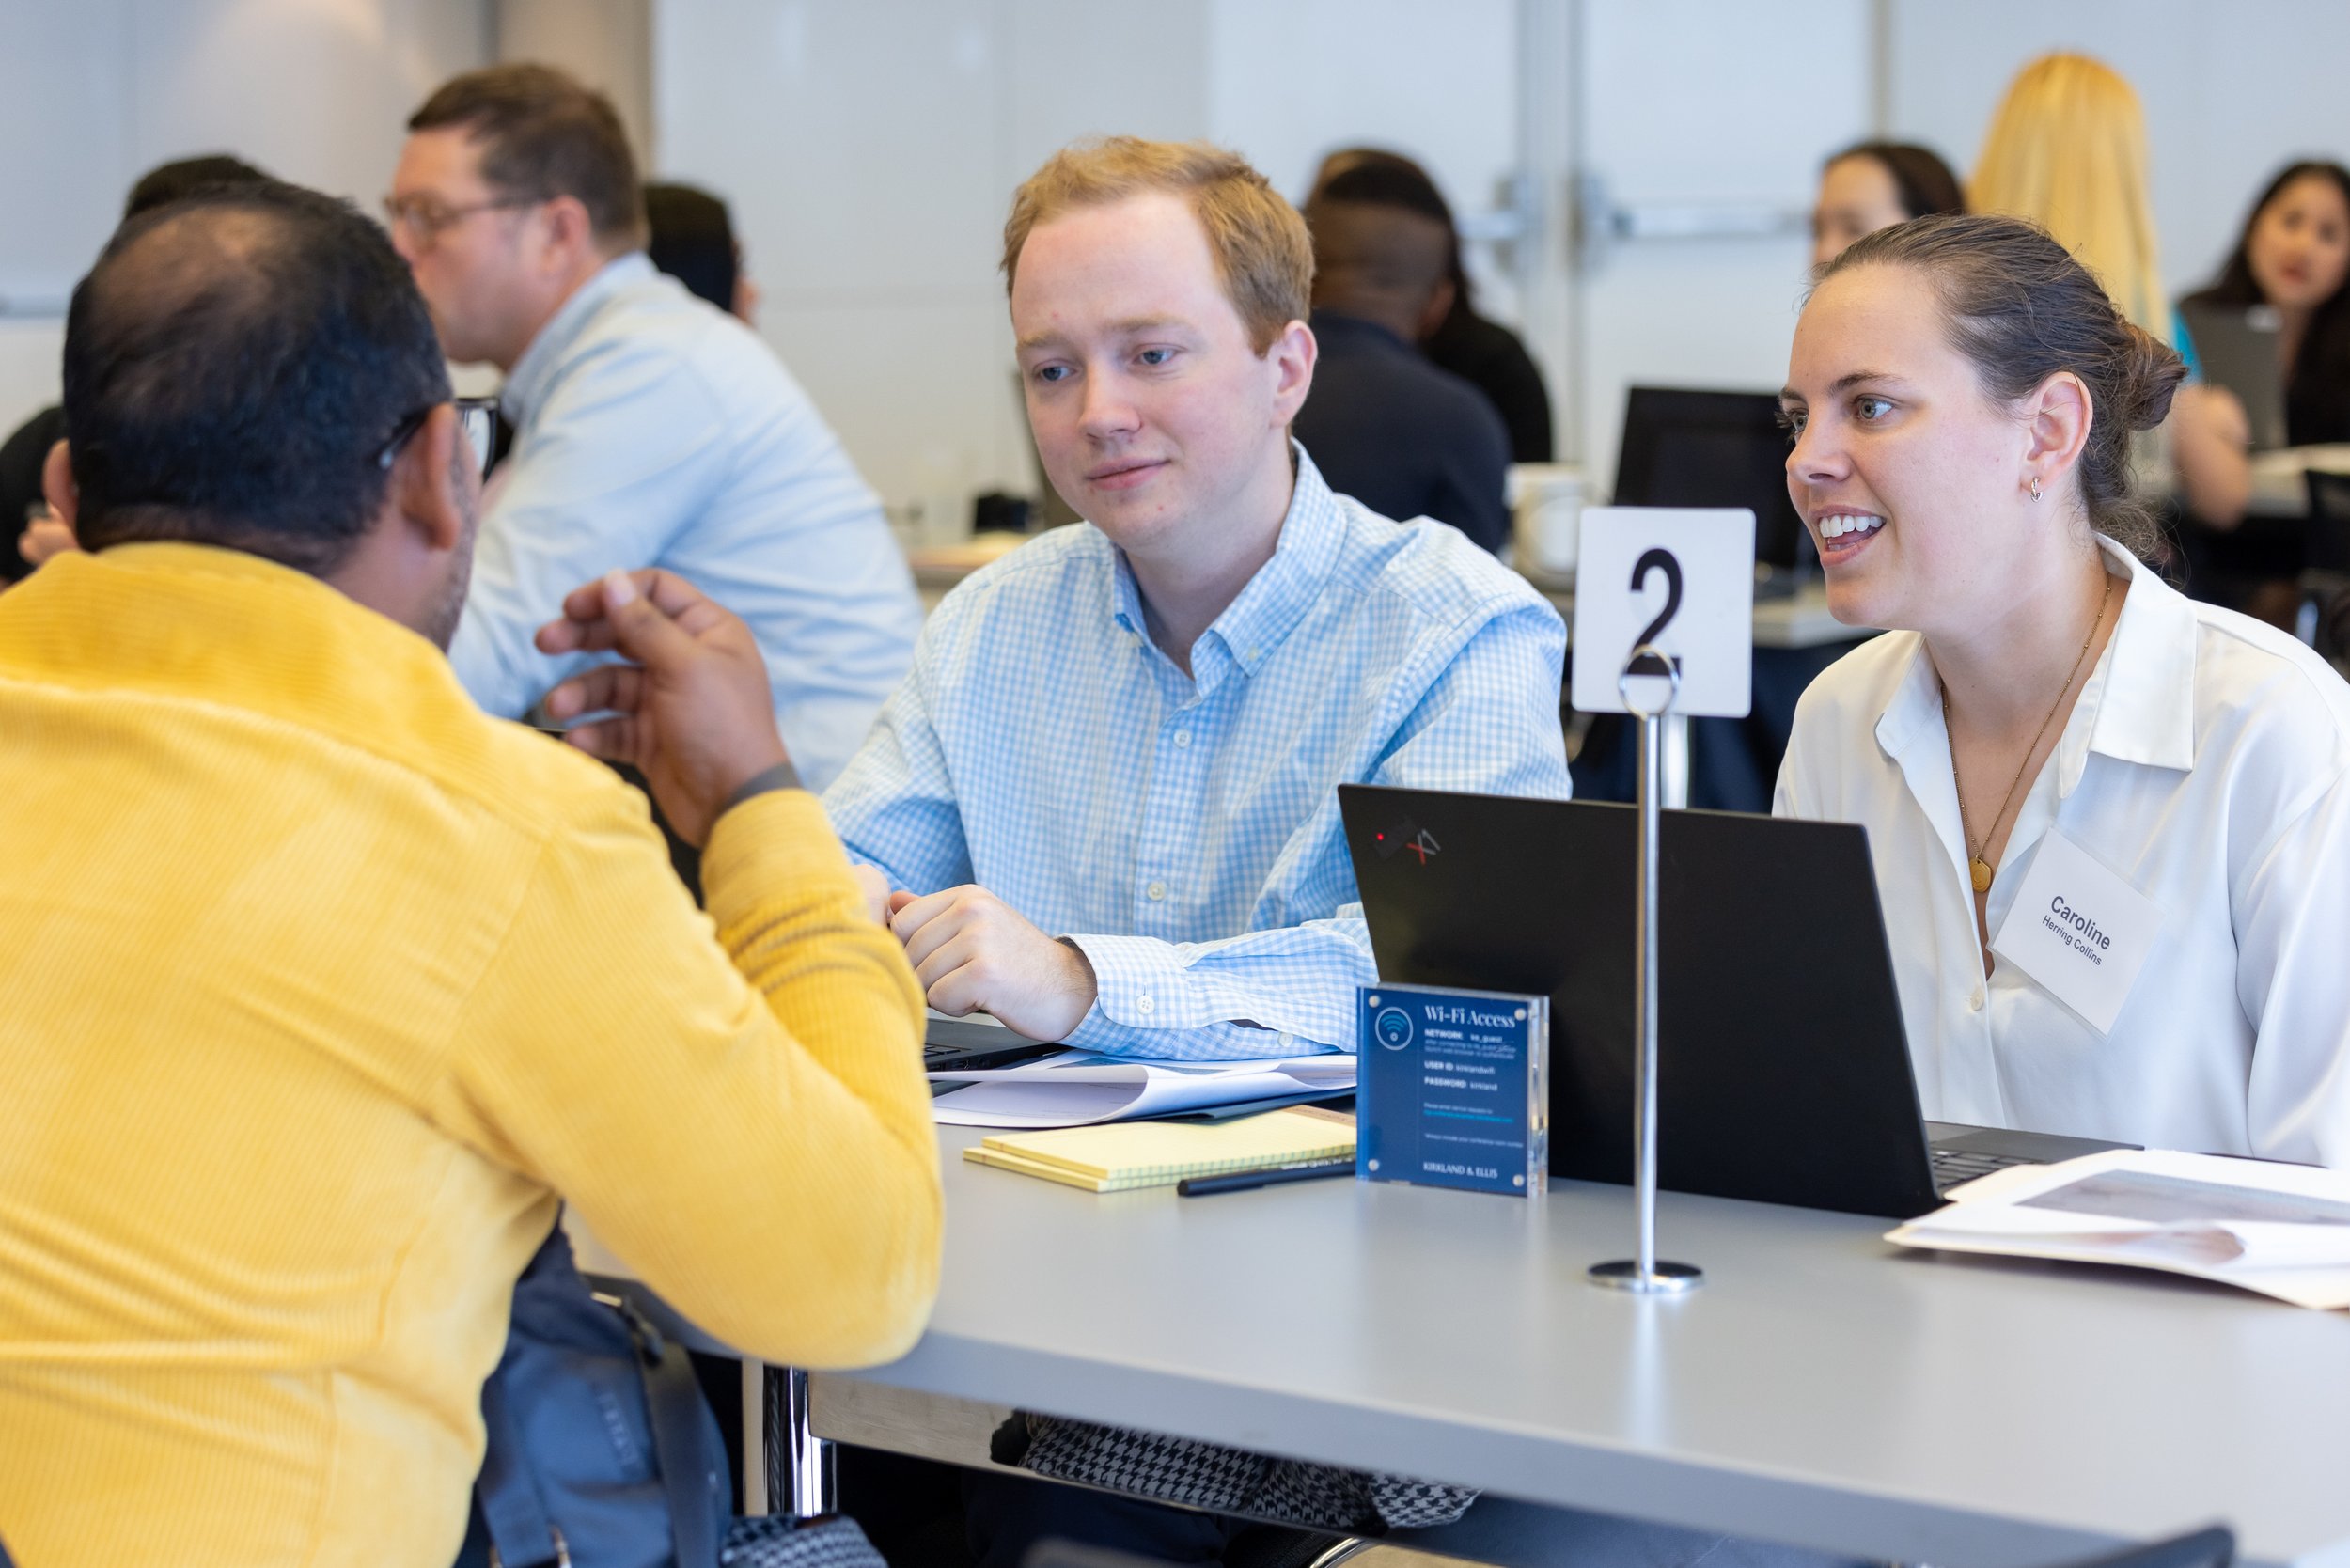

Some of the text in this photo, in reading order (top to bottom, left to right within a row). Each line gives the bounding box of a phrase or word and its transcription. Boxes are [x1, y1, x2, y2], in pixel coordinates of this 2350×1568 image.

[1625, 548, 1683, 680] 2
[2042, 915, 2102, 965] Herring Collins
[2051, 895, 2110, 950] Caroline
[1424, 1005, 1515, 1028] Wi-Fi Access
[1424, 1060, 1444, 1071] USER
[1423, 1162, 1498, 1179] KIRKLAND & ELLIS
